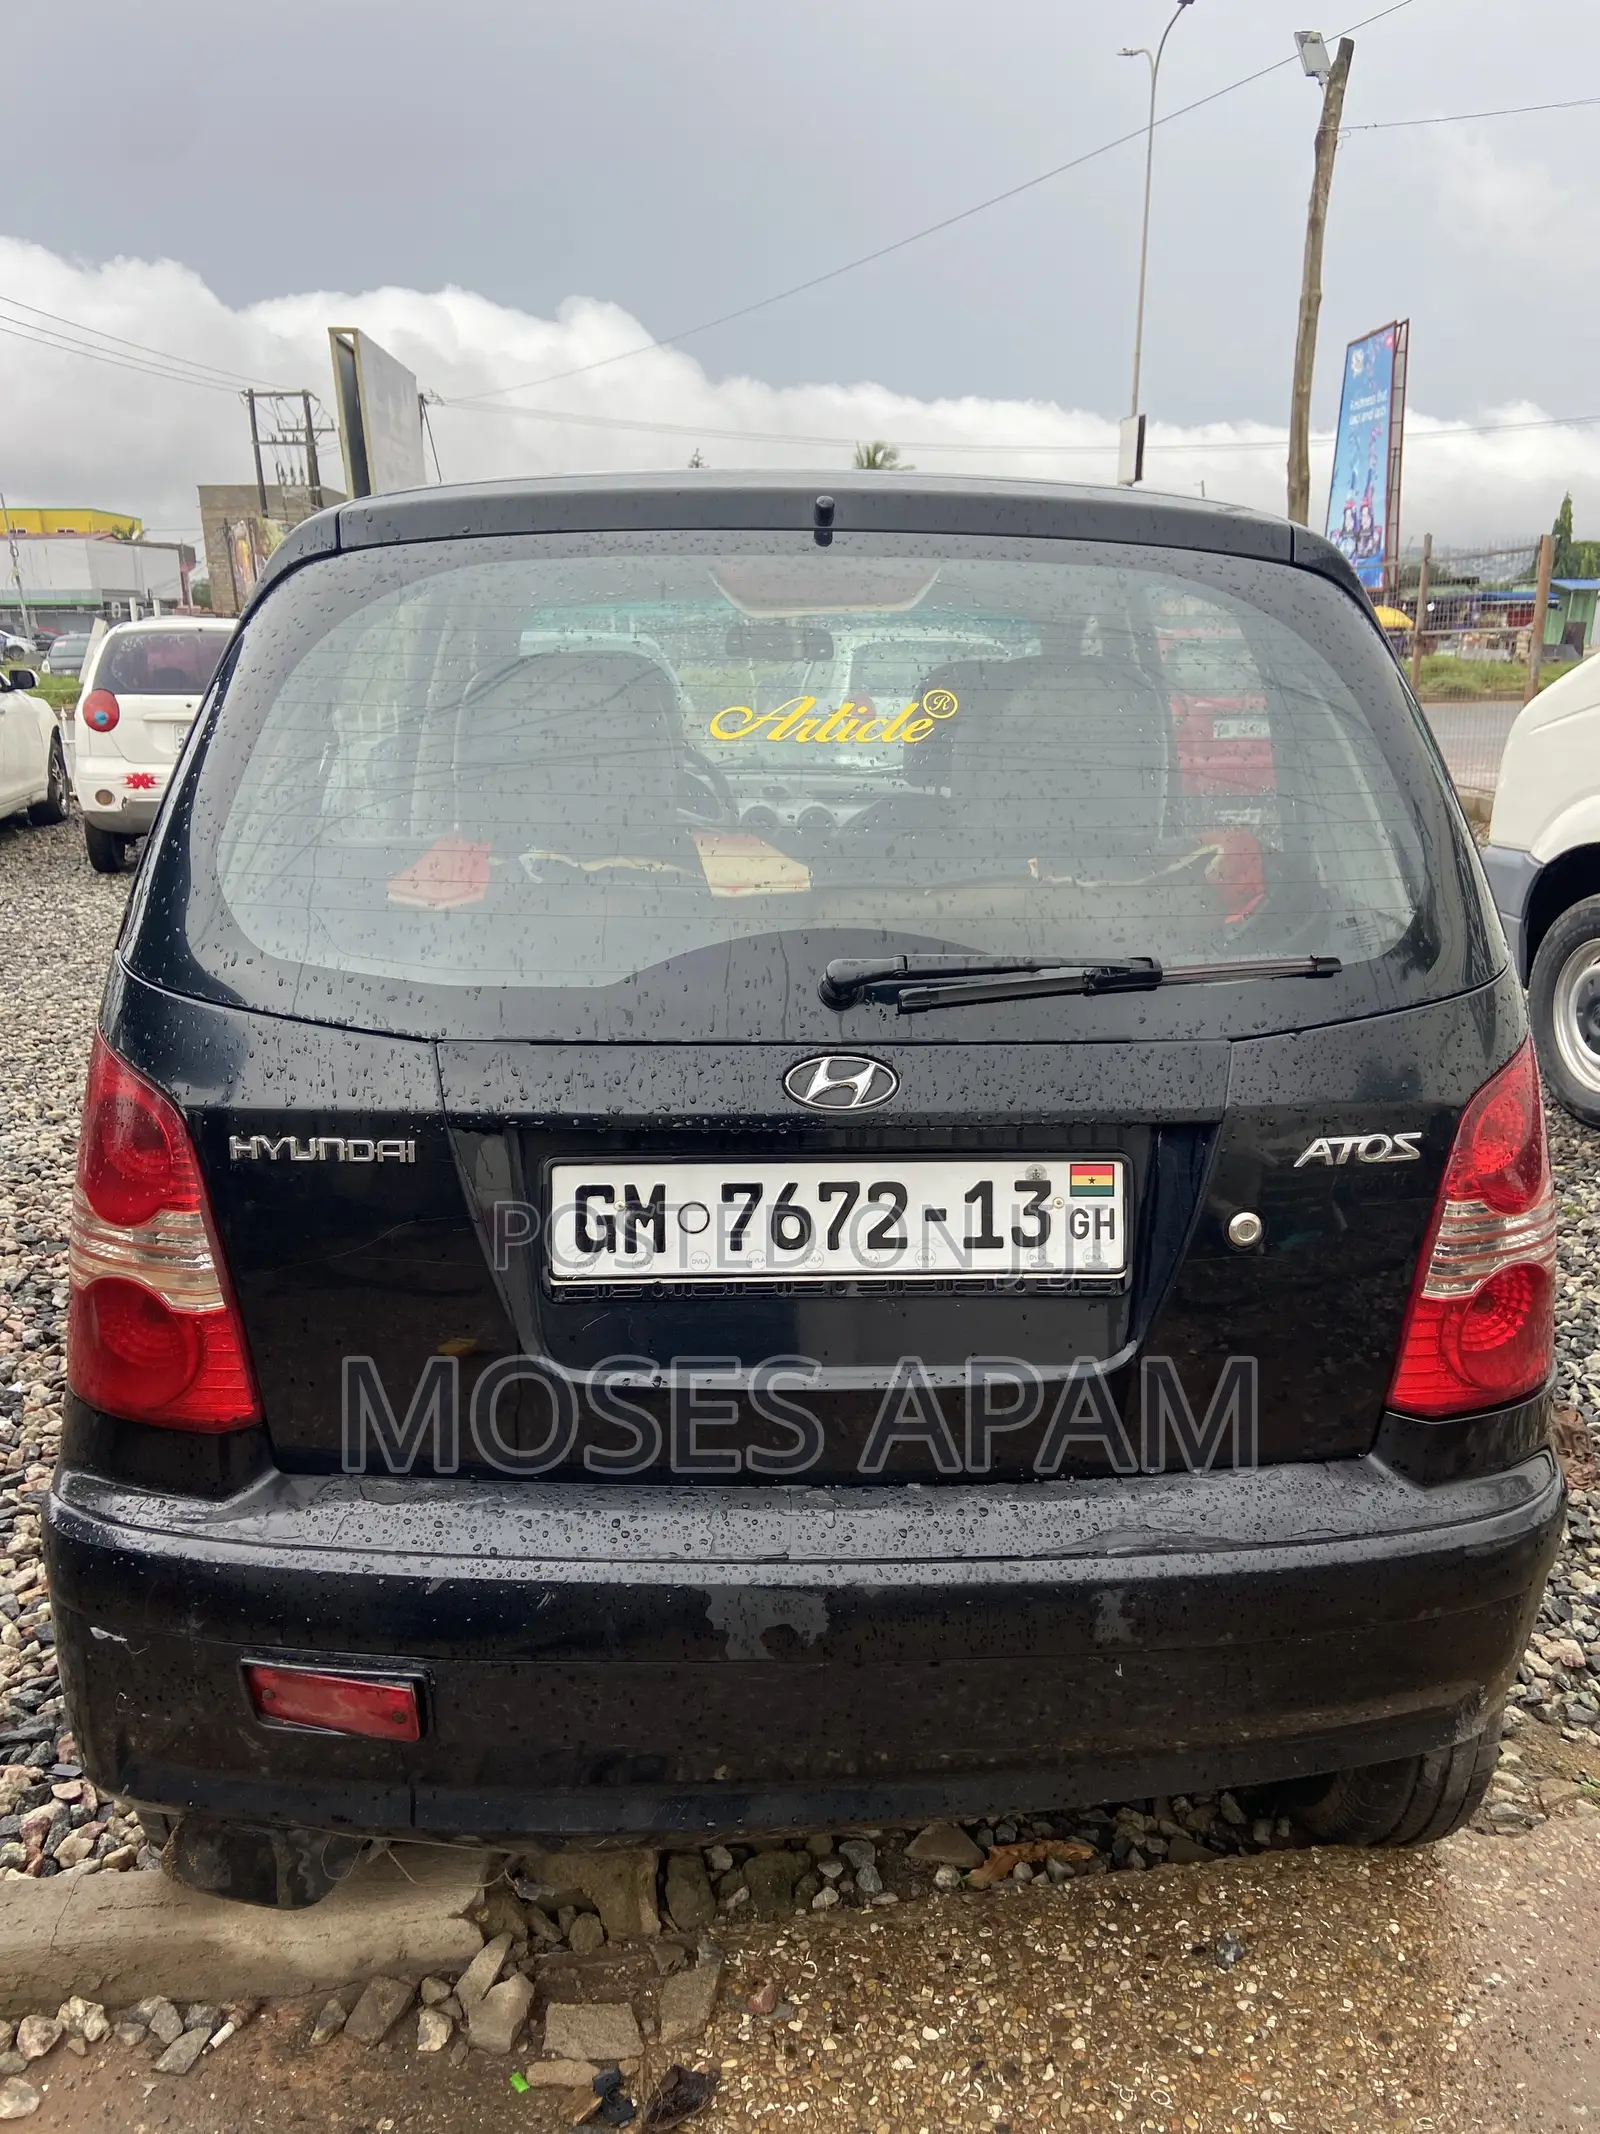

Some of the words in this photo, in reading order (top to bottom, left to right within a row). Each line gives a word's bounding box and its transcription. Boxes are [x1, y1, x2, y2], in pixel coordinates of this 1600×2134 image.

[709, 695, 935, 744] Article
[229, 1135, 416, 1163] HYUNDAI
[1293, 1132, 1422, 1167] ATOS
[575, 1183, 666, 1253] GM
[720, 1180, 1052, 1250] 7672-13
[1069, 1207, 1115, 1241] GH
